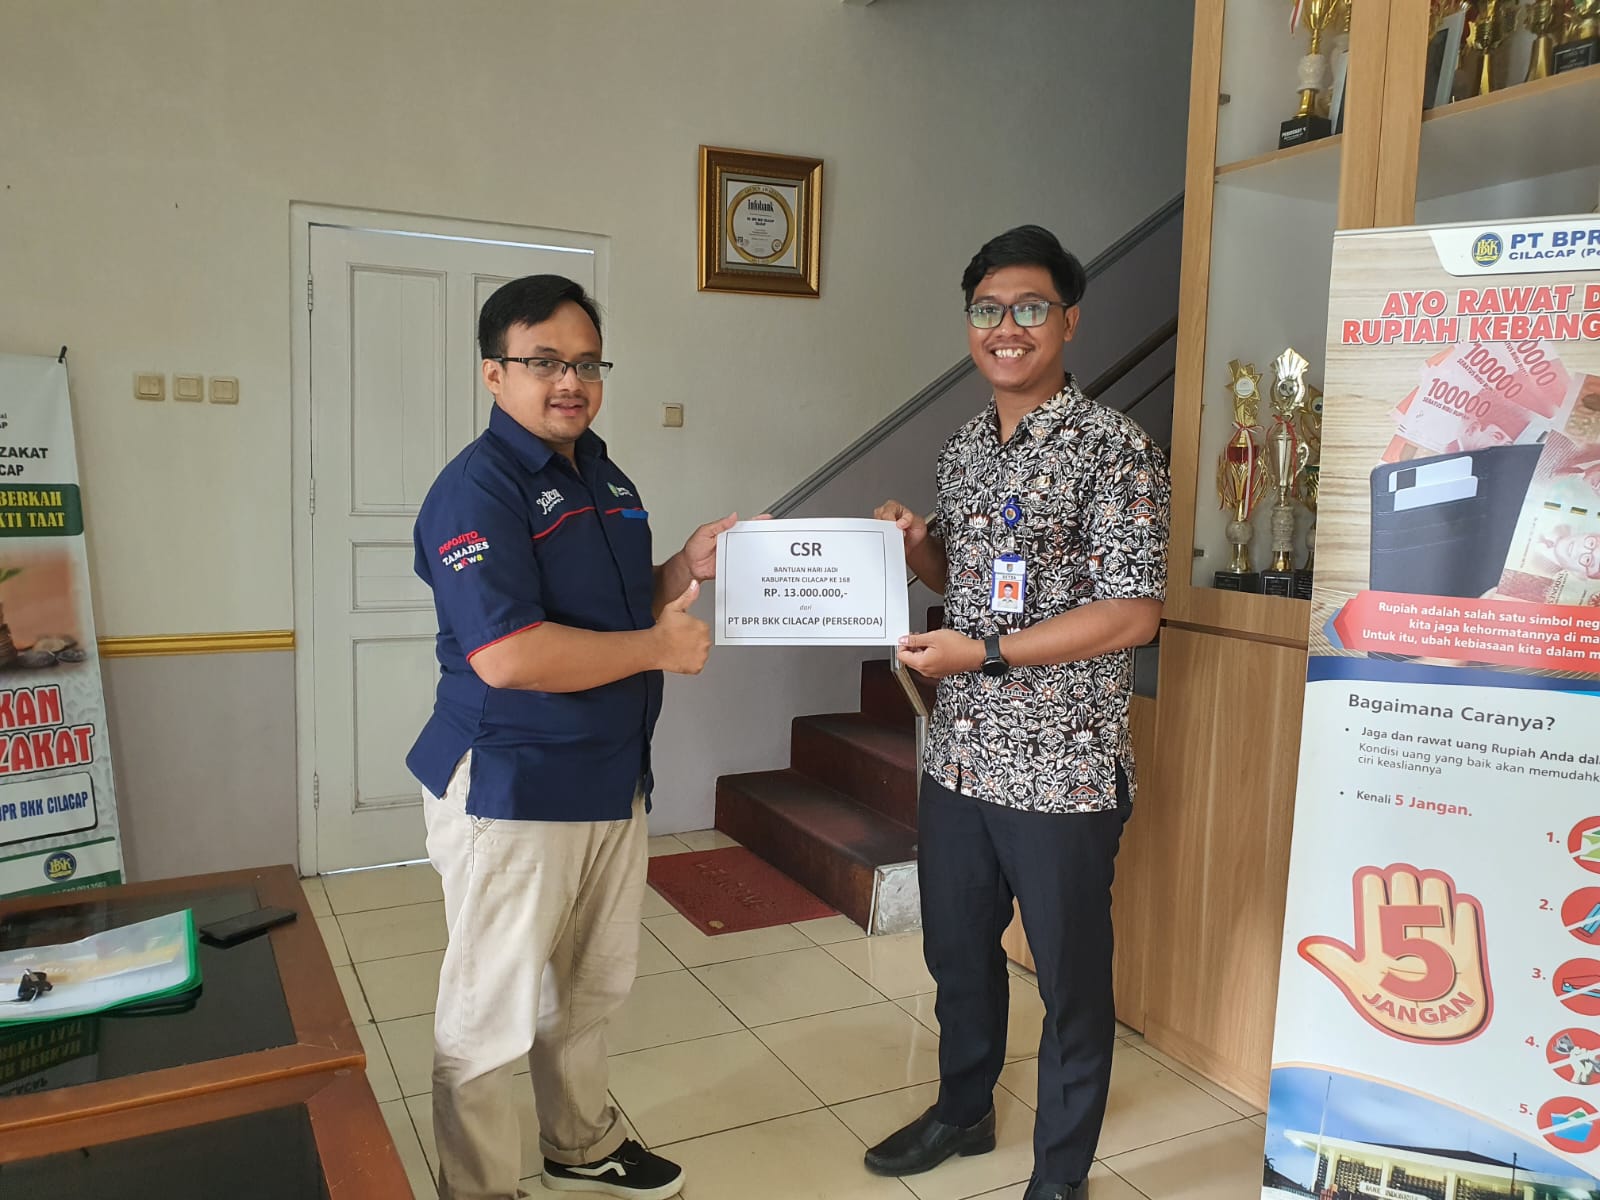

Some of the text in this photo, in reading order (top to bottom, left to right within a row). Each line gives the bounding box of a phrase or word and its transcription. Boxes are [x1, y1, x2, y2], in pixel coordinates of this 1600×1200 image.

[1510, 229, 1600, 249] PT BPR
[1509, 249, 1576, 260] CILACAP
[1382, 290, 1446, 317] AYO
[1458, 285, 1573, 314] RAWAT
[1343, 313, 1600, 343] RUPIAH KEBANG
[1464, 343, 1523, 399] 100000
[1427, 378, 1491, 418] 100000
[0, 446, 48, 459] ZAKAT
[0, 464, 24, 476] CAP
[0, 490, 63, 507] BERKAH
[27, 512, 65, 527] TAAT
[438, 530, 478, 555] DEPOSITO
[442, 541, 490, 566] TAMADES
[790, 542, 822, 556] CSR
[764, 588, 848, 599] RP. 13.000.000,-
[728, 616, 883, 627] PT BPR BKK CILACAP (PERSERODA)
[1378, 601, 1600, 631] Rupiah adalah salah satu simbol neg
[1362, 628, 1395, 641] Untuk
[1399, 631, 1418, 645] itu,
[1421, 633, 1451, 646] ubah
[1454, 634, 1515, 653] kebiasaan
[1518, 641, 1542, 655] kita
[1546, 644, 1586, 659] dalam
[1409, 618, 1600, 645] kita jaga kehormatannya di ma
[0, 686, 62, 729] KAN
[1349, 693, 1556, 732] Bagaimana Caranya?
[0, 726, 93, 773] ZAKAT
[1361, 726, 1388, 740] Jaga
[1391, 730, 1413, 742] dan
[1417, 735, 1452, 748] rawat
[1456, 740, 1488, 754] uang
[1491, 743, 1536, 759] Rupiah
[1540, 749, 1575, 763] Anda
[1358, 755, 1443, 776] ciri keasliannya
[1359, 742, 1600, 783] Kondisi uang yang baik akan memudahk
[0, 791, 89, 822] PR BKK CILACAP
[1356, 789, 1473, 817] Kenali 5 Jangan.
[1546, 831, 1560, 844] 1.
[1539, 899, 1553, 911] 2.
[1378, 904, 1455, 1002] 5
[1531, 967, 1546, 981] 3.
[1361, 990, 1476, 1025] JANGAN
[1524, 1036, 1539, 1048] 4.
[1518, 1103, 1533, 1116] 5.
